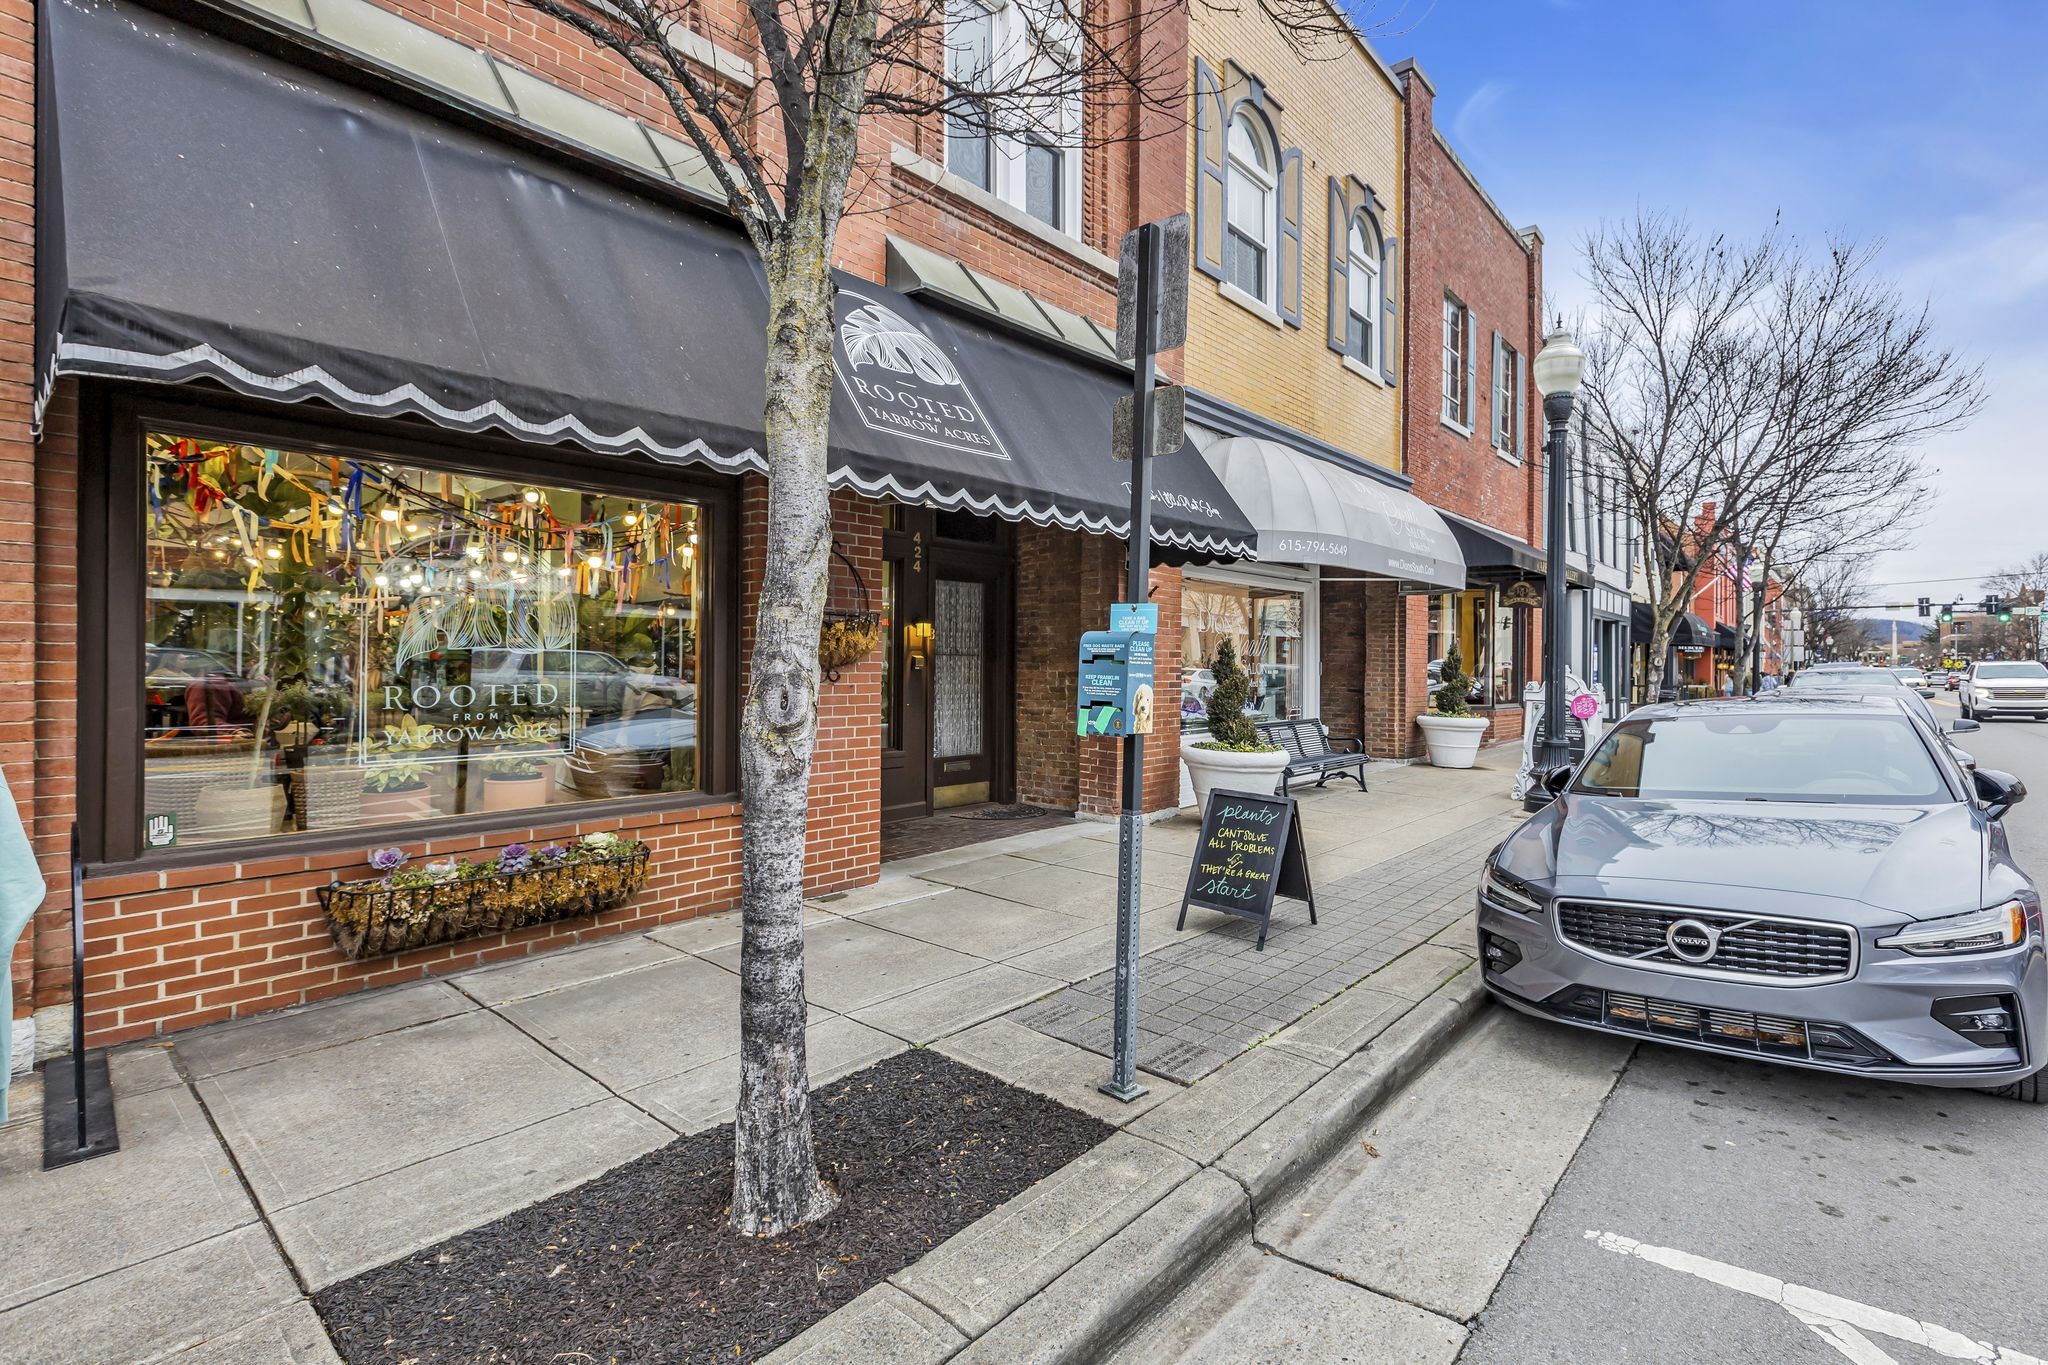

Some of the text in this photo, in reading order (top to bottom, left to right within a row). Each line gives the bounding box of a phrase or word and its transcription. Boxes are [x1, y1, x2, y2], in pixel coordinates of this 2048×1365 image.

[851, 375, 974, 422] ROOTED
[867, 405, 991, 446] YARROW ACRES
[909, 410, 942, 423] FROM
[913, 531, 922, 573] 424
[1279, 539, 1348, 556] 615-794-5649
[382, 684, 558, 711] ROOTED
[453, 712, 499, 722] FROM
[383, 723, 558, 746] YARROW ACRES
[1216, 805, 1279, 825] plants
[1243, 830, 1269, 842] SOLVE
[1208, 837, 1276, 855] ALL PROBLEMS
[1200, 863, 1271, 882] THEY'RE A GREAT
[1197, 876, 1257, 900] start
[1673, 937, 1708, 946] VOLVO
